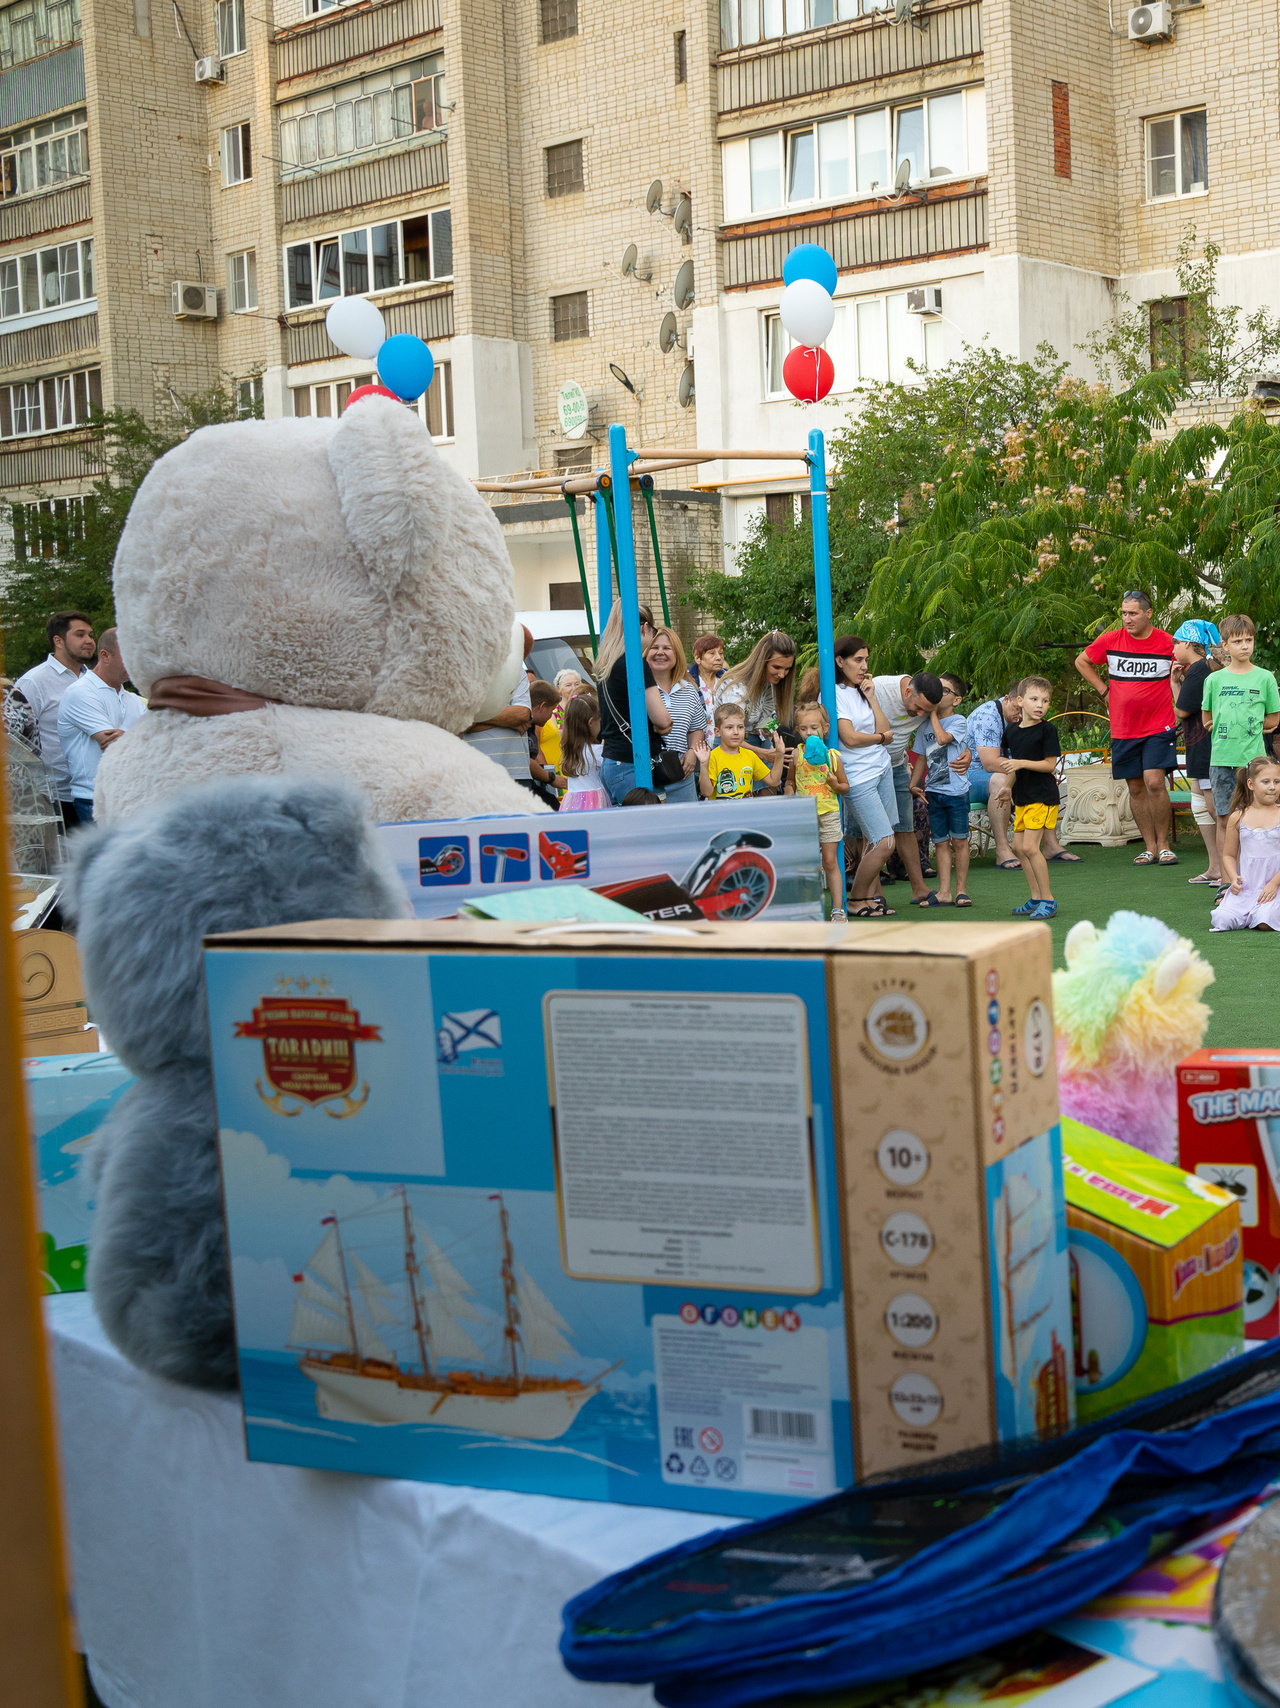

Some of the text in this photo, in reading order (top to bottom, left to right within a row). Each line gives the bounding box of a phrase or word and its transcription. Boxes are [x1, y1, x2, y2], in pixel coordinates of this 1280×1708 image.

[1116, 658, 1158, 676] Kappa
[1192, 1093, 1237, 1120] THE
[887, 1146, 923, 1169] 10+
[890, 1311, 933, 1331] 1:200
